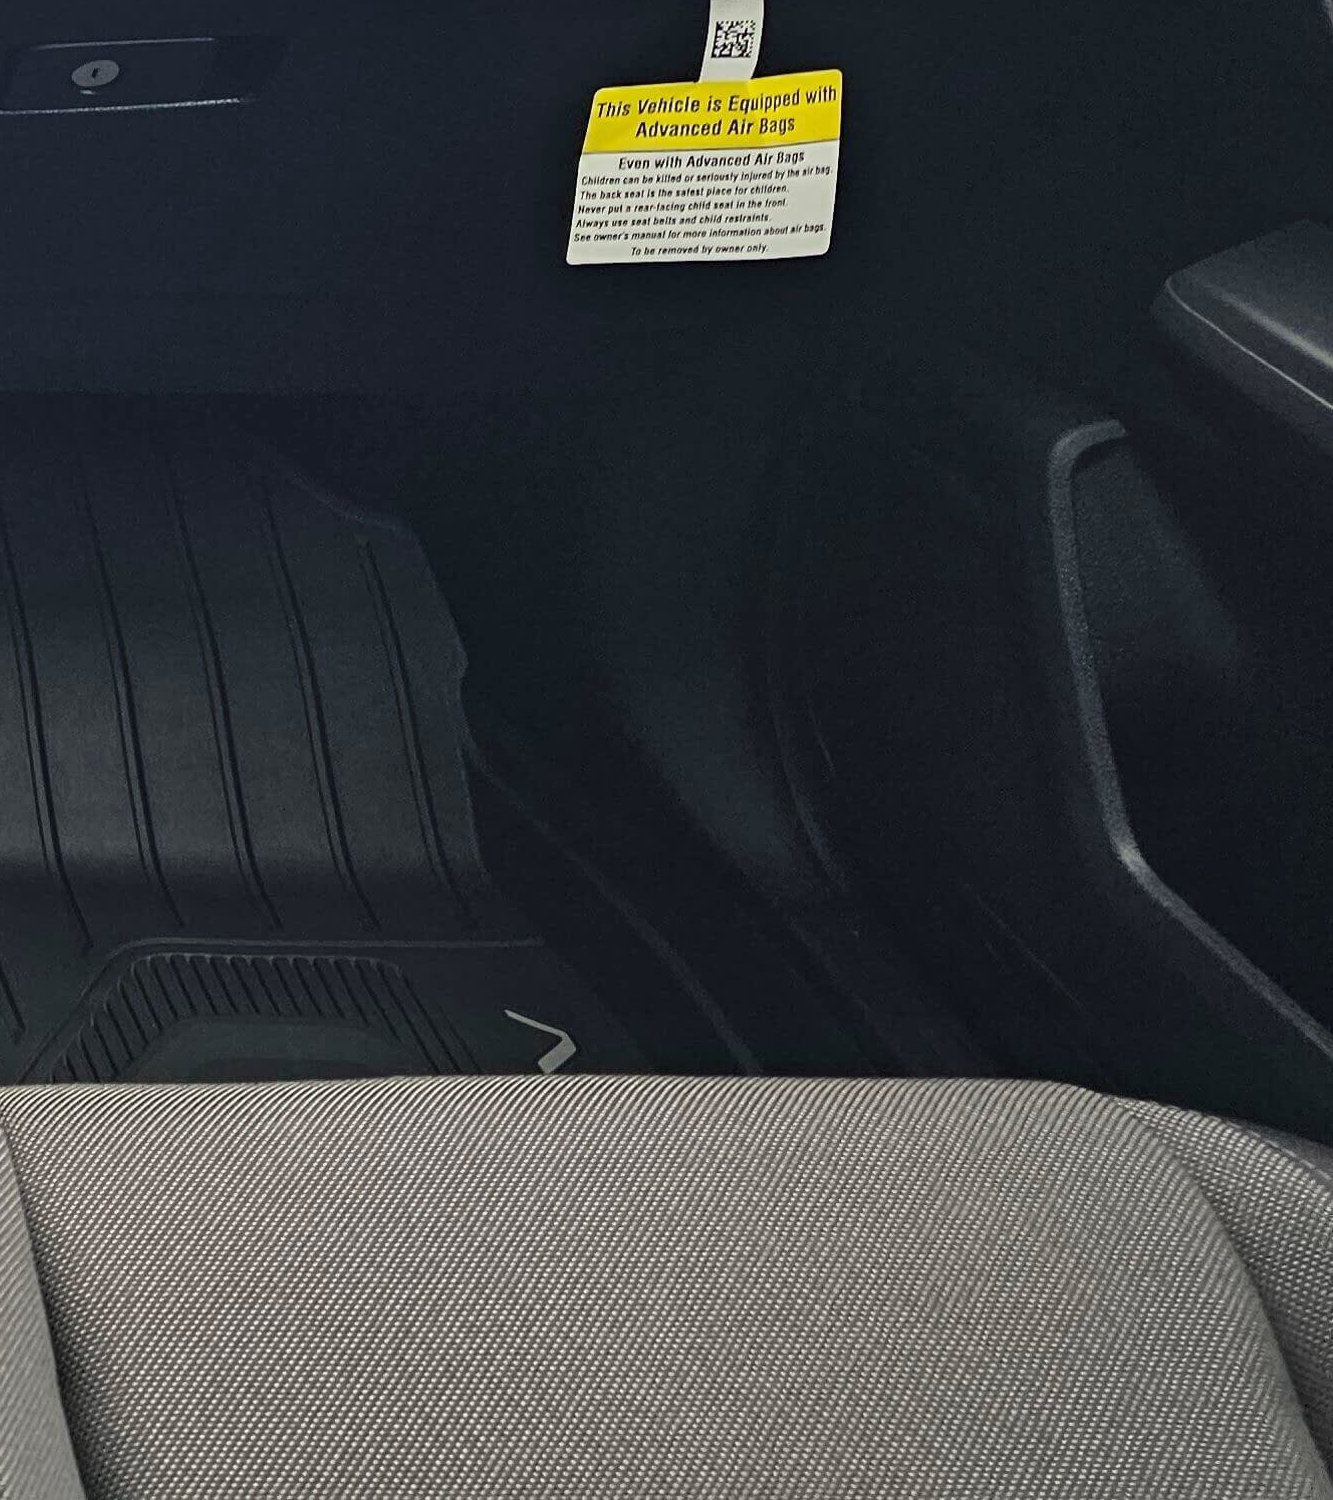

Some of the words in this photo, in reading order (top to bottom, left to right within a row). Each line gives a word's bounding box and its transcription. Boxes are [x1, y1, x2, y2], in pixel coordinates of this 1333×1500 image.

[597, 101, 631, 118] This
[638, 97, 700, 115] Vehicle
[707, 96, 722, 113] is
[729, 91, 800, 114] Equipped
[806, 86, 837, 103] with
[635, 119, 722, 139] Advanced
[727, 118, 753, 135] Air
[759, 117, 795, 135] Bags
[618, 157, 650, 170] Even
[655, 156, 682, 169] with
[686, 153, 751, 167] Advanced
[754, 153, 773, 165] Air
[777, 150, 805, 165] Bags
[581, 175, 620, 186] Children
[623, 175, 640, 185] can
[642, 174, 653, 184] be
[656, 174, 682, 184] killed
[684, 174, 694, 183] or
[697, 172, 738, 182] seriously
[740, 170, 773, 182] injured
[775, 170, 785, 180] by
[787, 169, 799, 178] the
[802, 167, 813, 176] air
[815, 165, 832, 175] bag.
[581, 190, 597, 200] The
[600, 190, 622, 199] back
[624, 189, 644, 198] seat
[647, 189, 655, 198] is
[658, 188, 672, 197] the
[675, 187, 704, 197] safest
[706, 187, 732, 197] place
[734, 185, 747, 195] for
[578, 205, 606, 214] Never
[608, 204, 623, 215] put
[625, 205, 631, 213] a
[688, 200, 711, 210] child
[714, 200, 733, 210] seat
[736, 200, 745, 209] in
[748, 200, 762, 208] the
[576, 219, 609, 229] Always
[612, 219, 628, 227] use
[631, 217, 651, 227] seat
[653, 217, 676, 226] belts
[679, 215, 697, 225] and
[699, 214, 722, 224] child
[574, 232, 591, 242] See
[593, 231, 629, 241] owner's
[631, 230, 666, 240] manual
[668, 230, 681, 239] for
[683, 230, 707, 238] more
[709, 227, 761, 238] information
[764, 226, 789, 236] about
[790, 224, 802, 233] air
[632, 246, 641, 256] To
[644, 246, 655, 255] be
[658, 244, 699, 255] removed
[702, 245, 713, 255] by
[715, 244, 744, 253] owner
